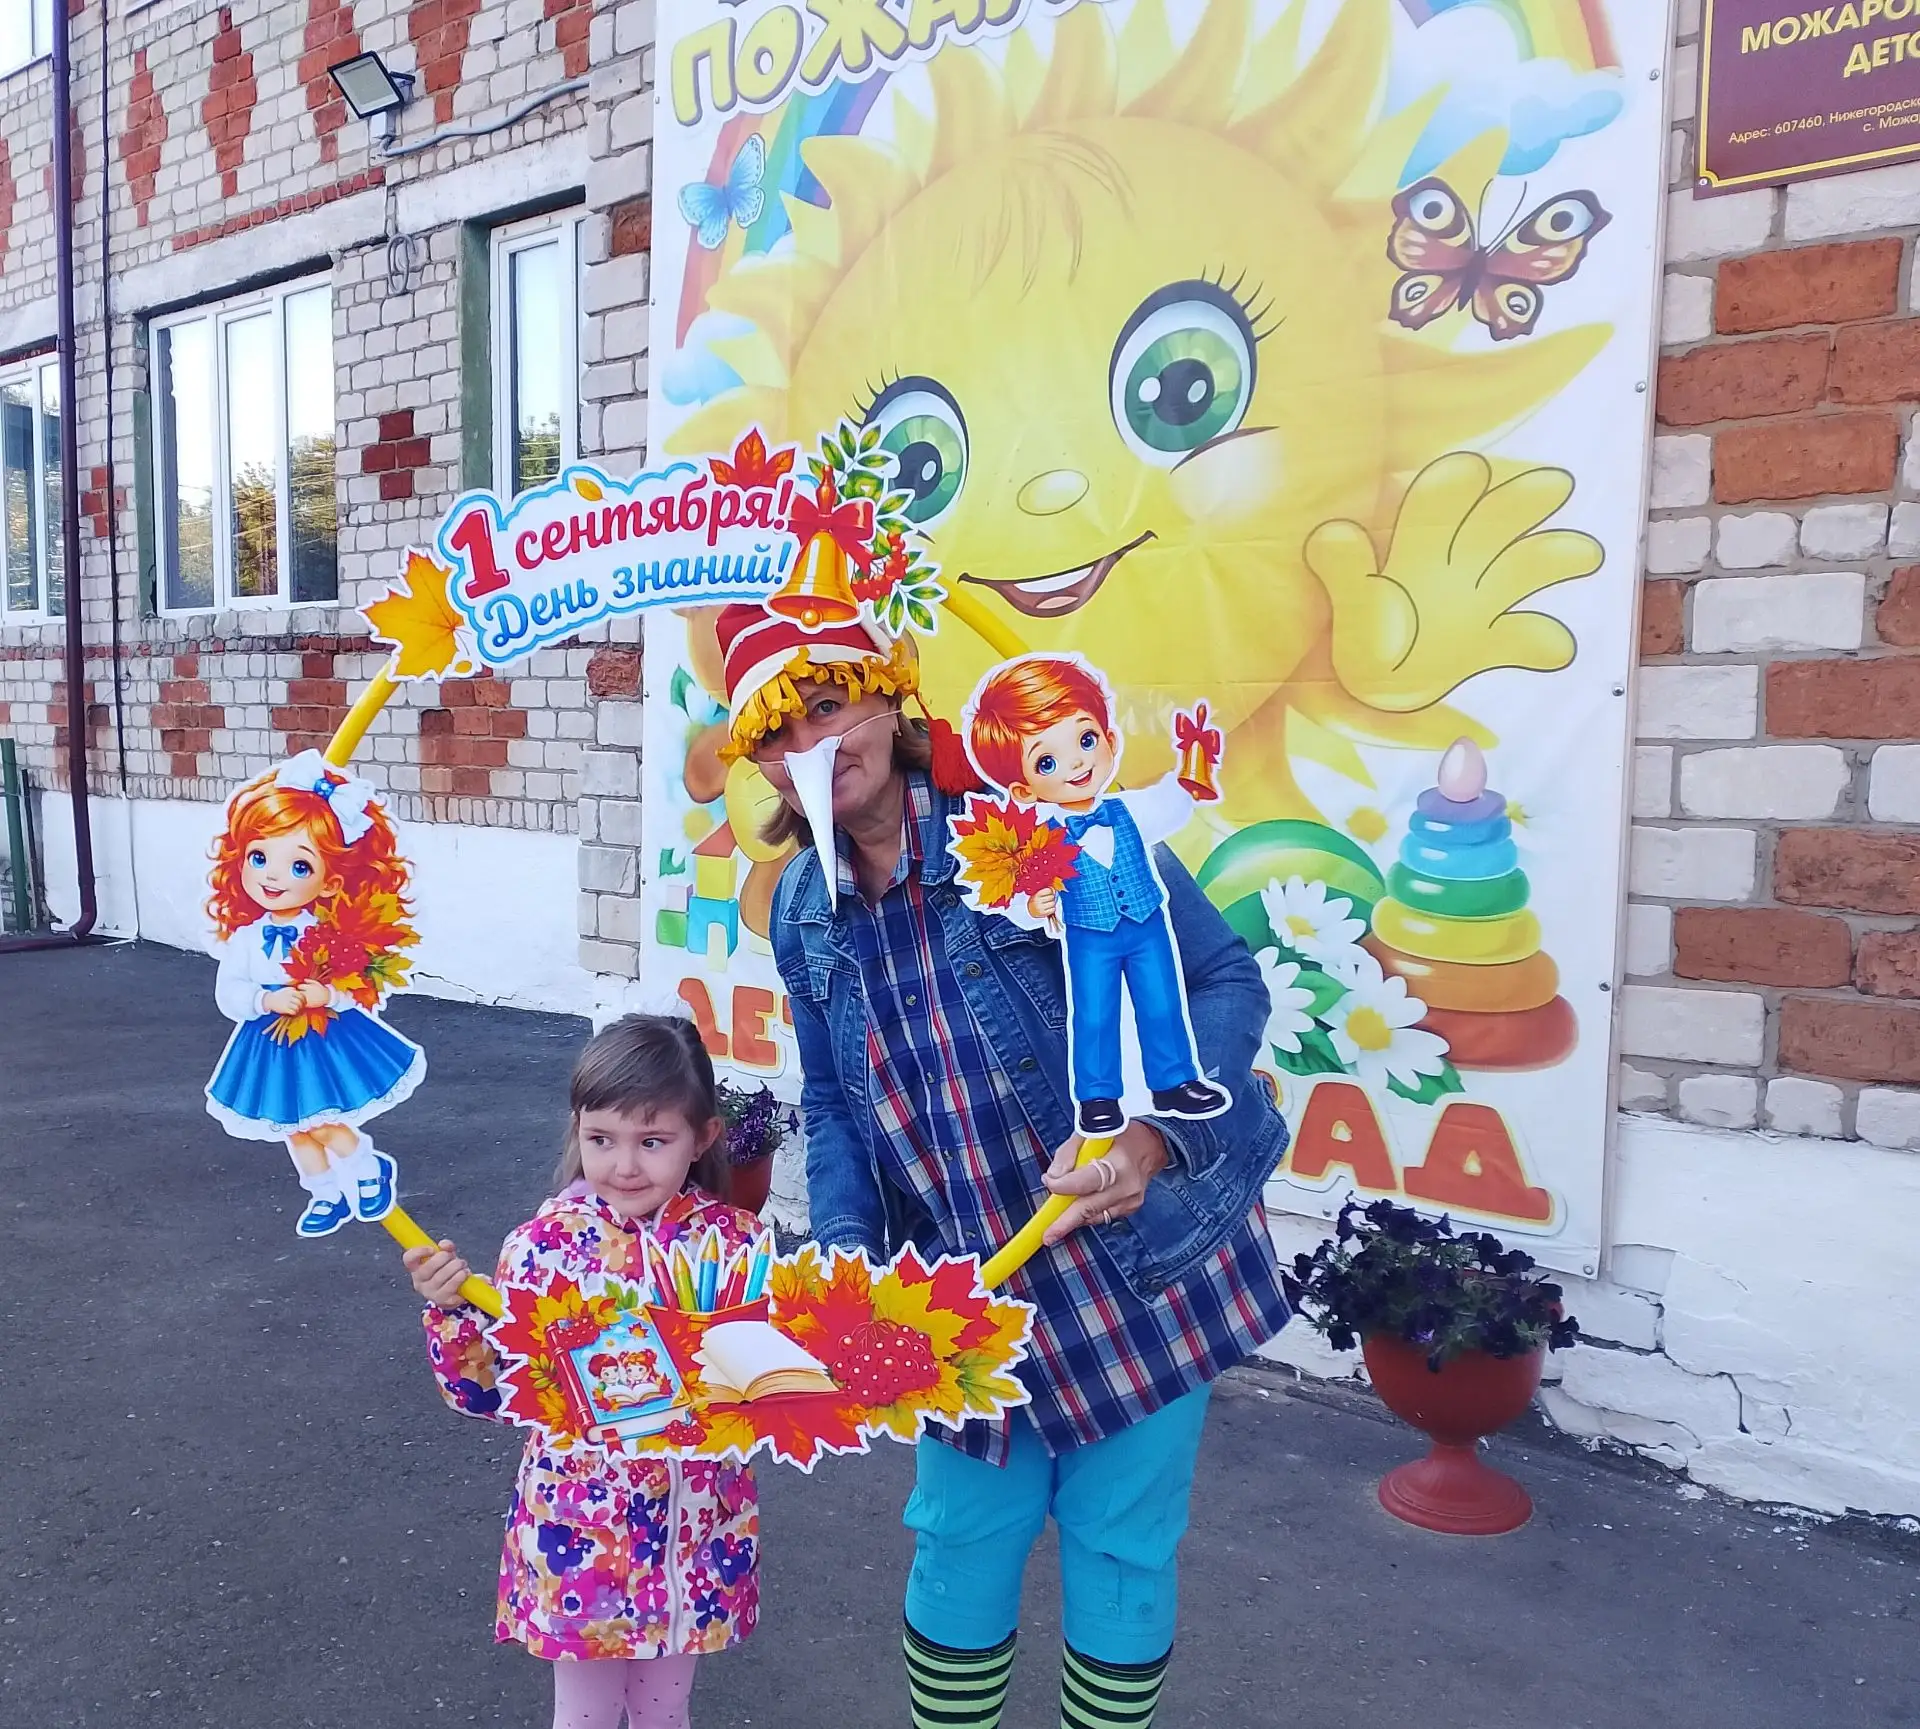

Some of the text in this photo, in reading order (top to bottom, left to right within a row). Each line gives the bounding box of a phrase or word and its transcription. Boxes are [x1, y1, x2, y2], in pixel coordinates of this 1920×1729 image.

[1728, 129, 1772, 144] Адрес:
[1774, 114, 1826, 135] 607460,
[1863, 122, 1875, 132] с.
[450, 474, 794, 599] 1 сентября!
[484, 542, 792, 647] День знаний!
[1251, 1069, 1552, 1222] АД
